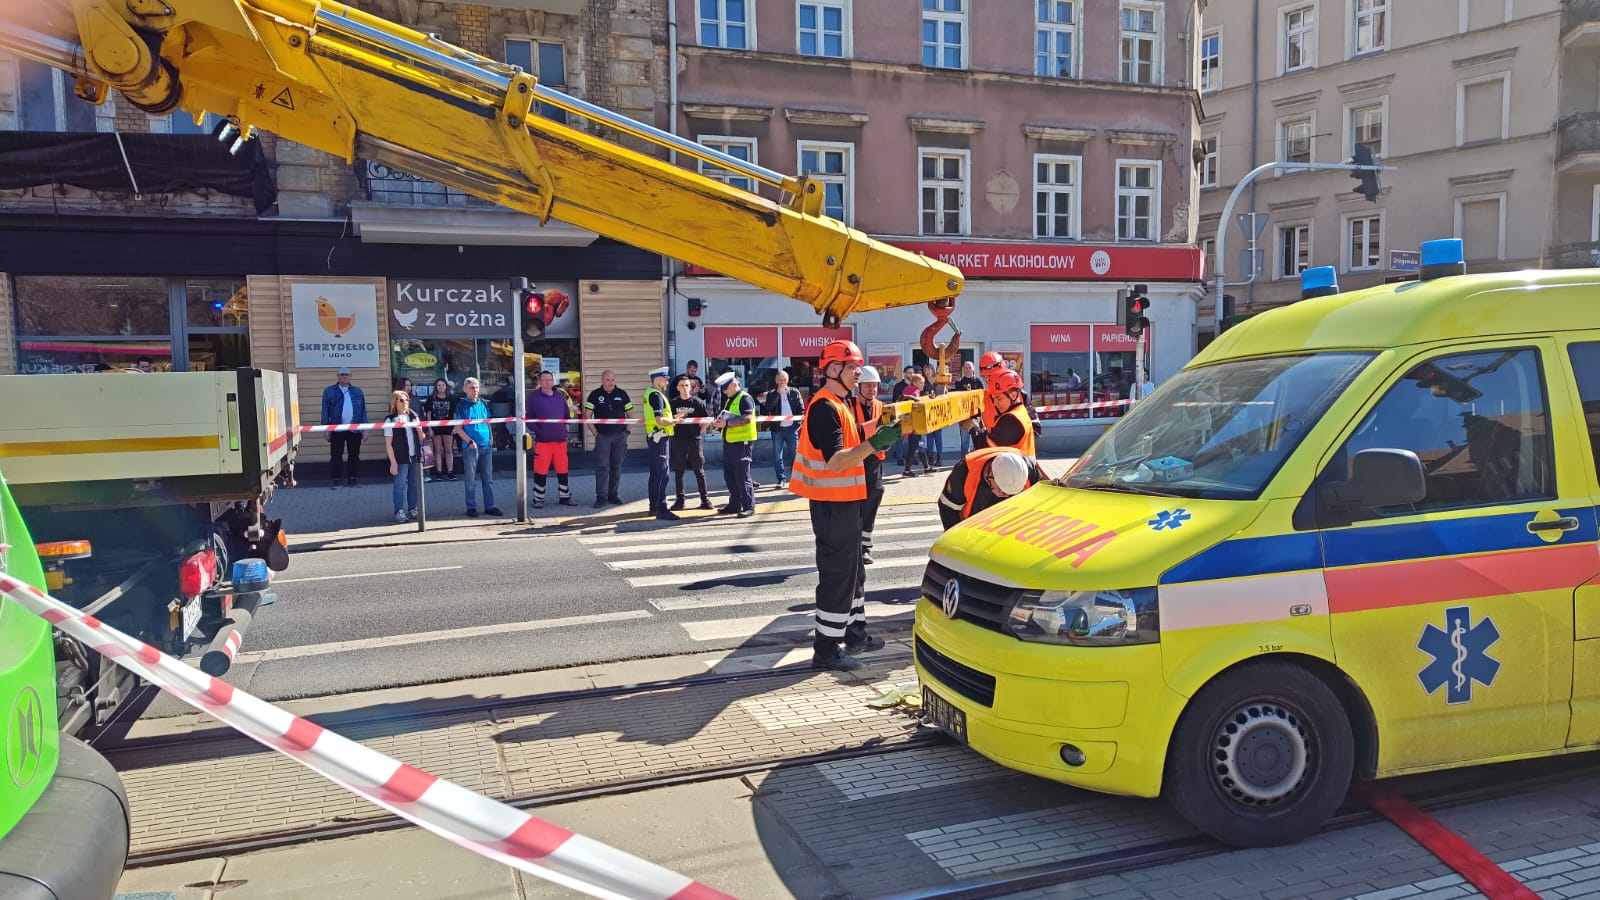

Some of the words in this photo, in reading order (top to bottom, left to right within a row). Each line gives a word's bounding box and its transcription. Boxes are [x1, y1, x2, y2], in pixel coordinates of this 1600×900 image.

[938, 253, 990, 268] MARKET
[994, 254, 1076, 269] ALKOHOLOWY
[396, 283, 503, 303] Kurczak
[425, 312, 436, 327] z
[445, 310, 506, 327] rożna
[725, 335, 758, 348] WÓDKI
[1050, 333, 1071, 343] WINA
[298, 342, 375, 352] SKRZYDEŁKO
[1271, 643, 1284, 652] bar
